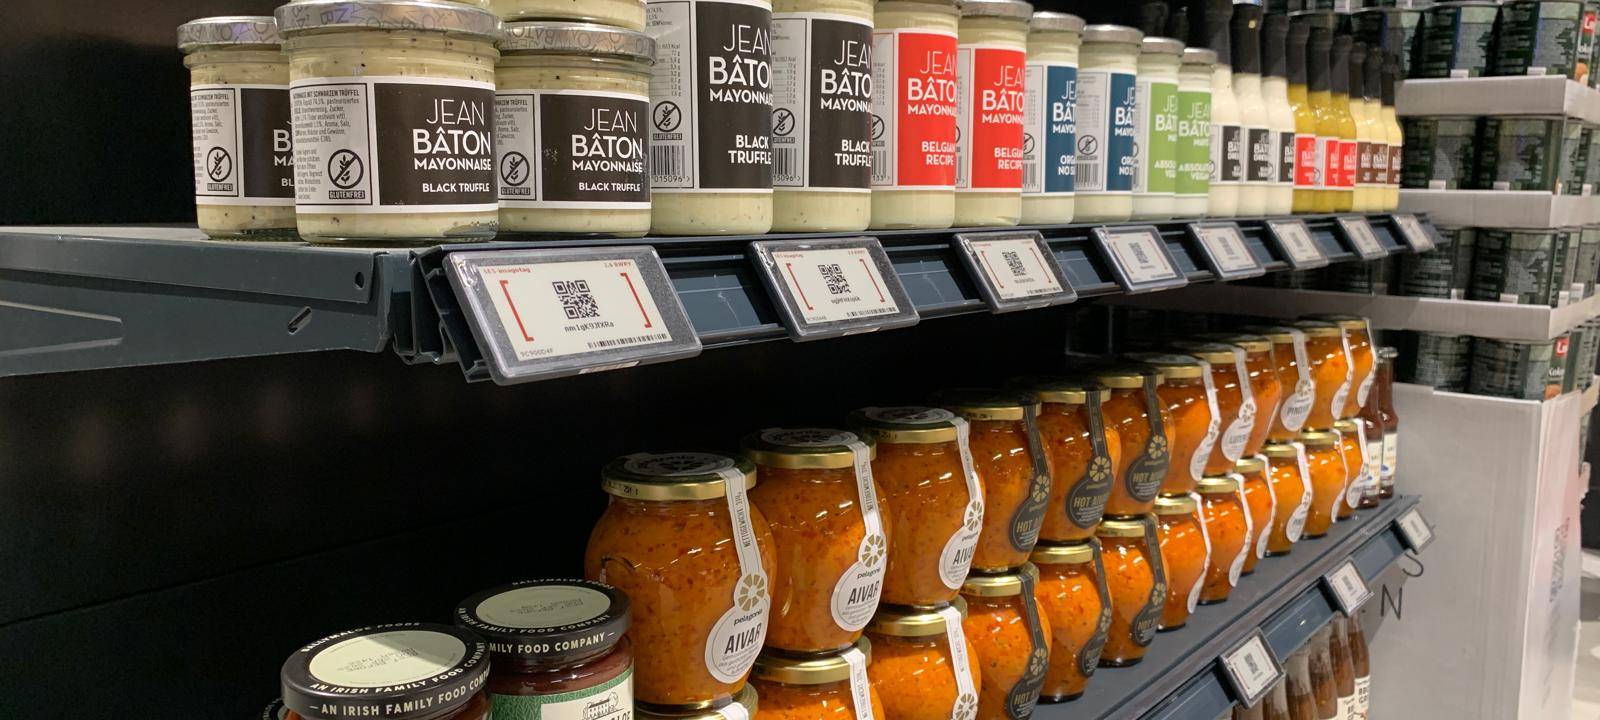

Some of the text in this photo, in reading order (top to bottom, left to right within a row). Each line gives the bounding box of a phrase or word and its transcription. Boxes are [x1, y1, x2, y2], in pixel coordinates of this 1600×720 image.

[723, 23, 772, 56] JEAN
[821, 67, 872, 98] BÂTO
[982, 88, 1025, 112] BÂTO
[426, 98, 485, 126] JEAN
[584, 108, 637, 133] JEAN
[1178, 119, 1210, 138] BÂTO
[412, 127, 491, 156] BÂTON
[571, 133, 643, 159] BÂTON
[736, 134, 769, 149] BLACK
[841, 139, 870, 153] BLACK
[414, 158, 492, 171] MAYONNAISE
[572, 160, 643, 173] MAYONNAISE
[728, 150, 772, 165] TRUFFLE
[834, 153, 872, 167] TRUFFLE
[926, 154, 954, 166] RECIPE
[329, 190, 365, 199] GLUTENFREI
[422, 182, 490, 193] BLACK TRUFFLE
[578, 182, 641, 192] BLACK TRUFFLE
[559, 614, 612, 632] COMPANY
[489, 631, 607, 655] MILY FOOD COMPANY
[724, 622, 762, 656] AIVAR
[309, 683, 326, 692] AN
[329, 685, 369, 694] IRISH
[374, 680, 428, 694] FAMILY
[431, 667, 464, 683] FOOD
[320, 703, 338, 716] AN
[342, 704, 380, 717] IRISH
[385, 697, 434, 715] FAMILY
[437, 685, 467, 705] FOOD
